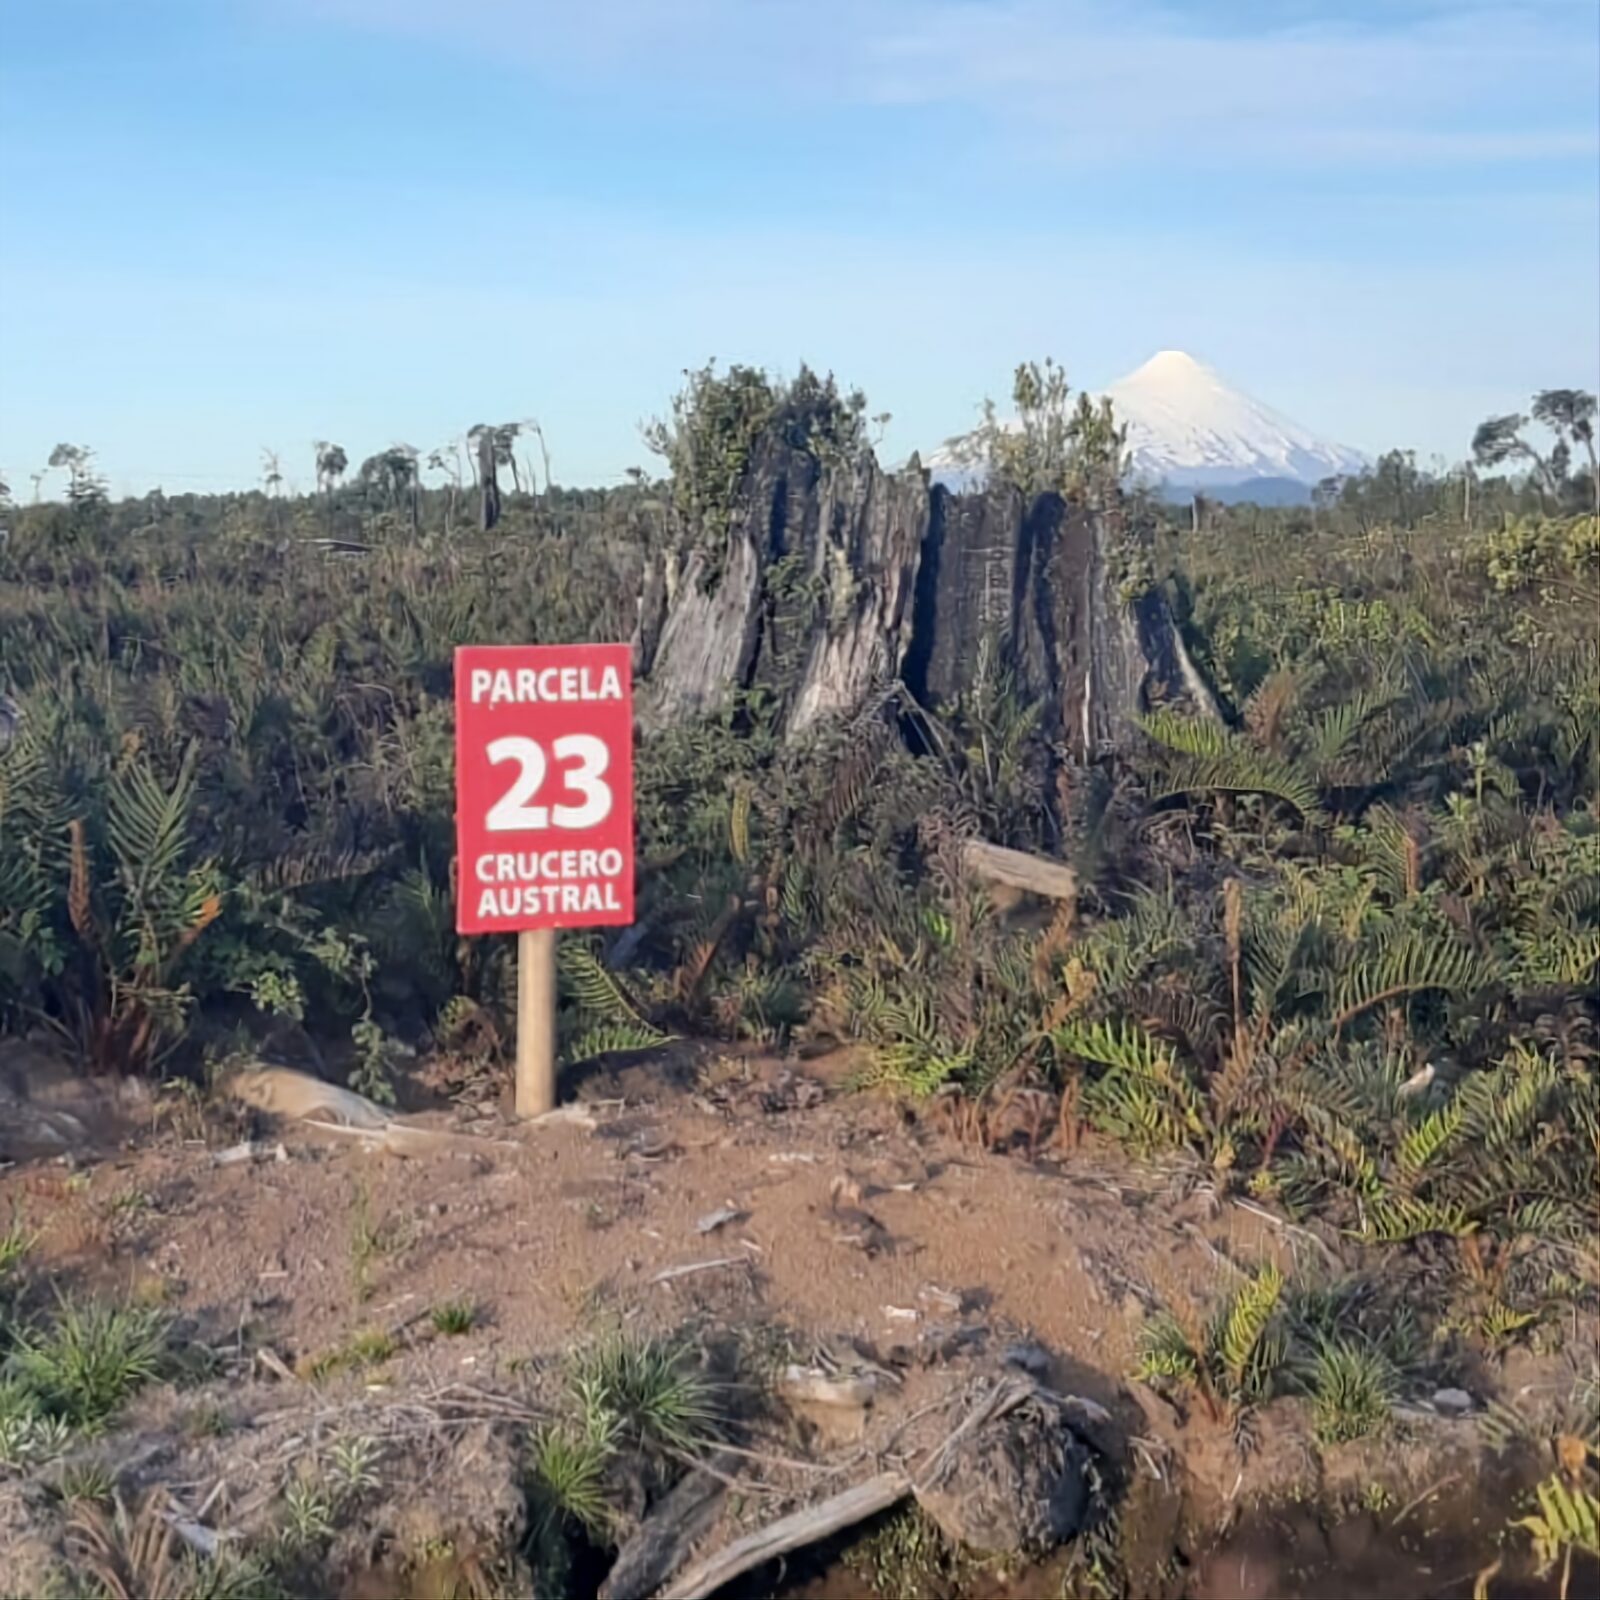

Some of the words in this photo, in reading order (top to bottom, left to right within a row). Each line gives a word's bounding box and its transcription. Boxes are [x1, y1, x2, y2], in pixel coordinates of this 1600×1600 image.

[471, 666, 623, 703] PARCELA
[485, 734, 613, 832] 23
[475, 848, 623, 882] CRUCERO
[477, 883, 621, 918] AUSTRAL
